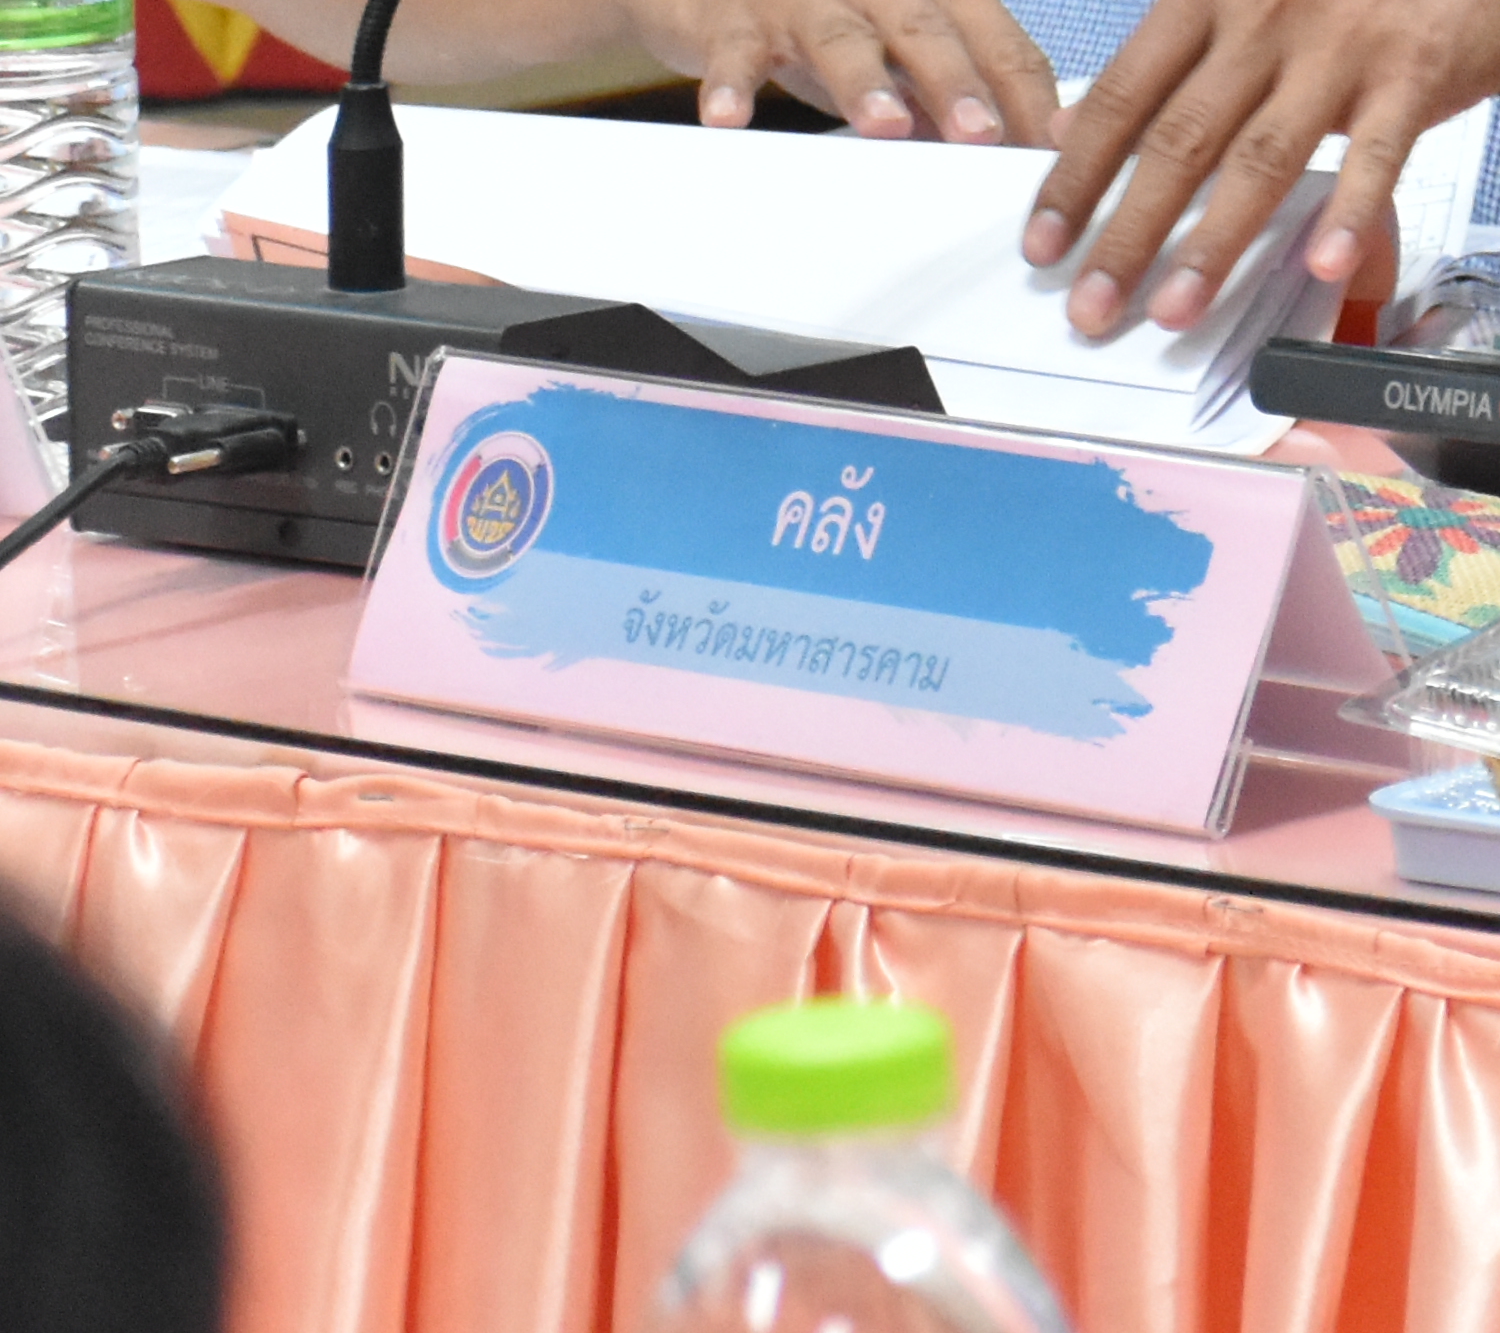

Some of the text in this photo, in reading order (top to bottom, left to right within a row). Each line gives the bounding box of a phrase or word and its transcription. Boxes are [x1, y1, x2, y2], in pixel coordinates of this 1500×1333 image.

[1383, 380, 1493, 422] OLYMPIA
[771, 464, 887, 561] คลัง
[622, 589, 950, 693] จังหวัดมหาสารคาม
